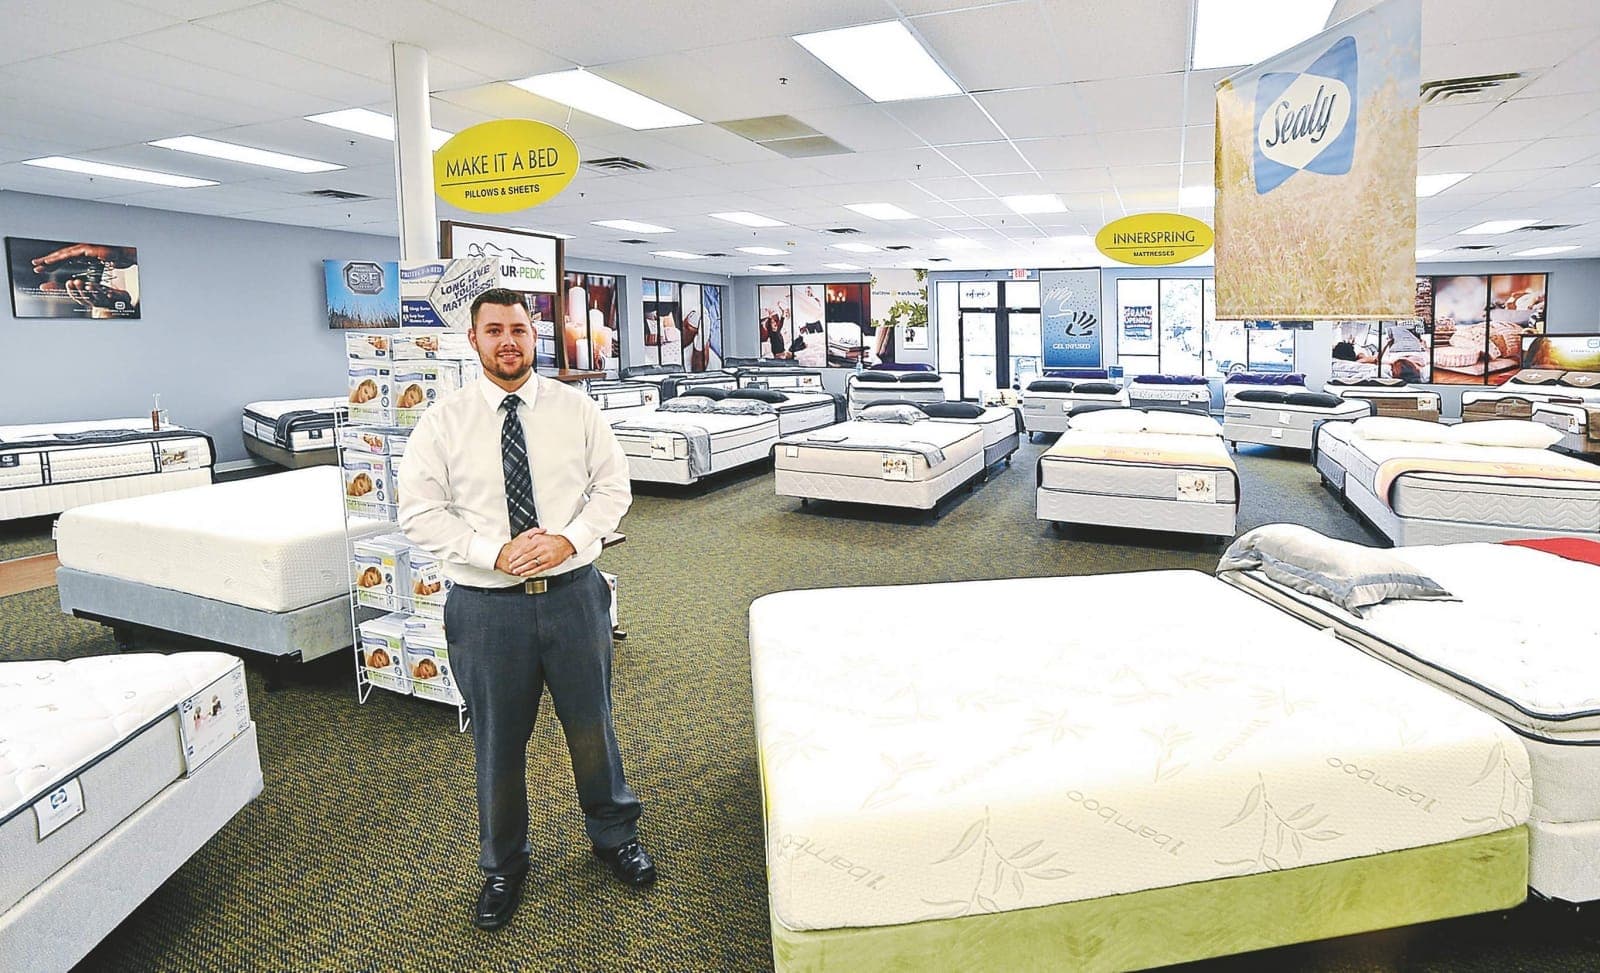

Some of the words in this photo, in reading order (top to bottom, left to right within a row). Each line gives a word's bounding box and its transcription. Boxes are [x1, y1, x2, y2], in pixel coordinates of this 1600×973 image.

[1265, 84, 1337, 148] Sealy
[446, 155, 489, 178] MAKE
[493, 152, 508, 173] IT
[512, 151, 524, 171] A
[528, 147, 559, 169] BED
[464, 188, 499, 199] PILLOWS
[500, 187, 506, 196] &
[508, 184, 540, 195] SHEETS
[1113, 230, 1195, 244] INNERSPRING
[440, 278, 466, 295] LONG
[468, 264, 490, 282] LIVE
[454, 279, 478, 299] YOUR
